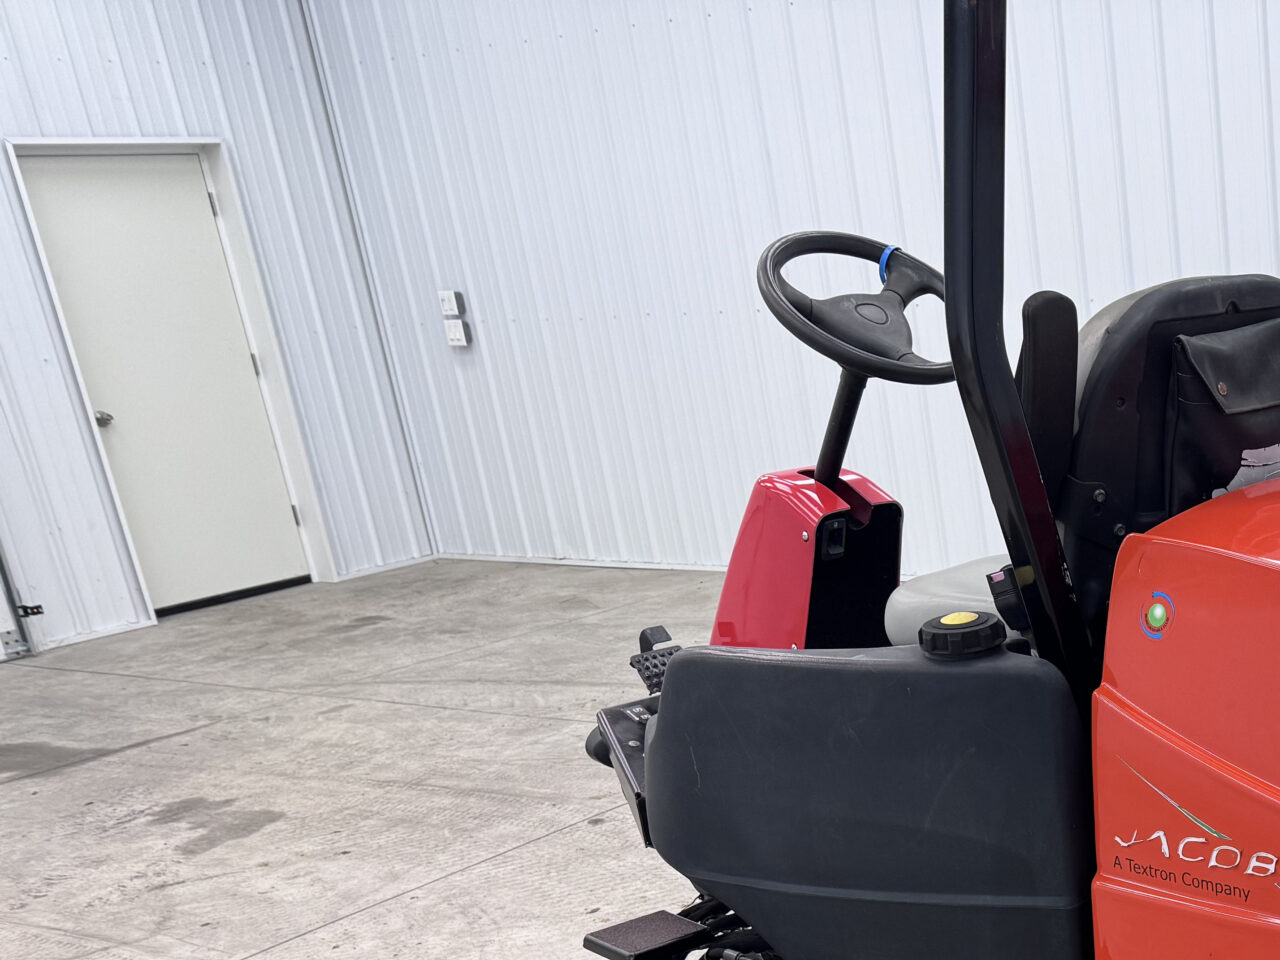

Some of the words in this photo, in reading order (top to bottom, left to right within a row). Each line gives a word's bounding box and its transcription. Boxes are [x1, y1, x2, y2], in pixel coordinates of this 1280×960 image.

[1113, 855, 1123, 870] A
[1125, 857, 1177, 883] Textron
[1181, 872, 1251, 903] Company
